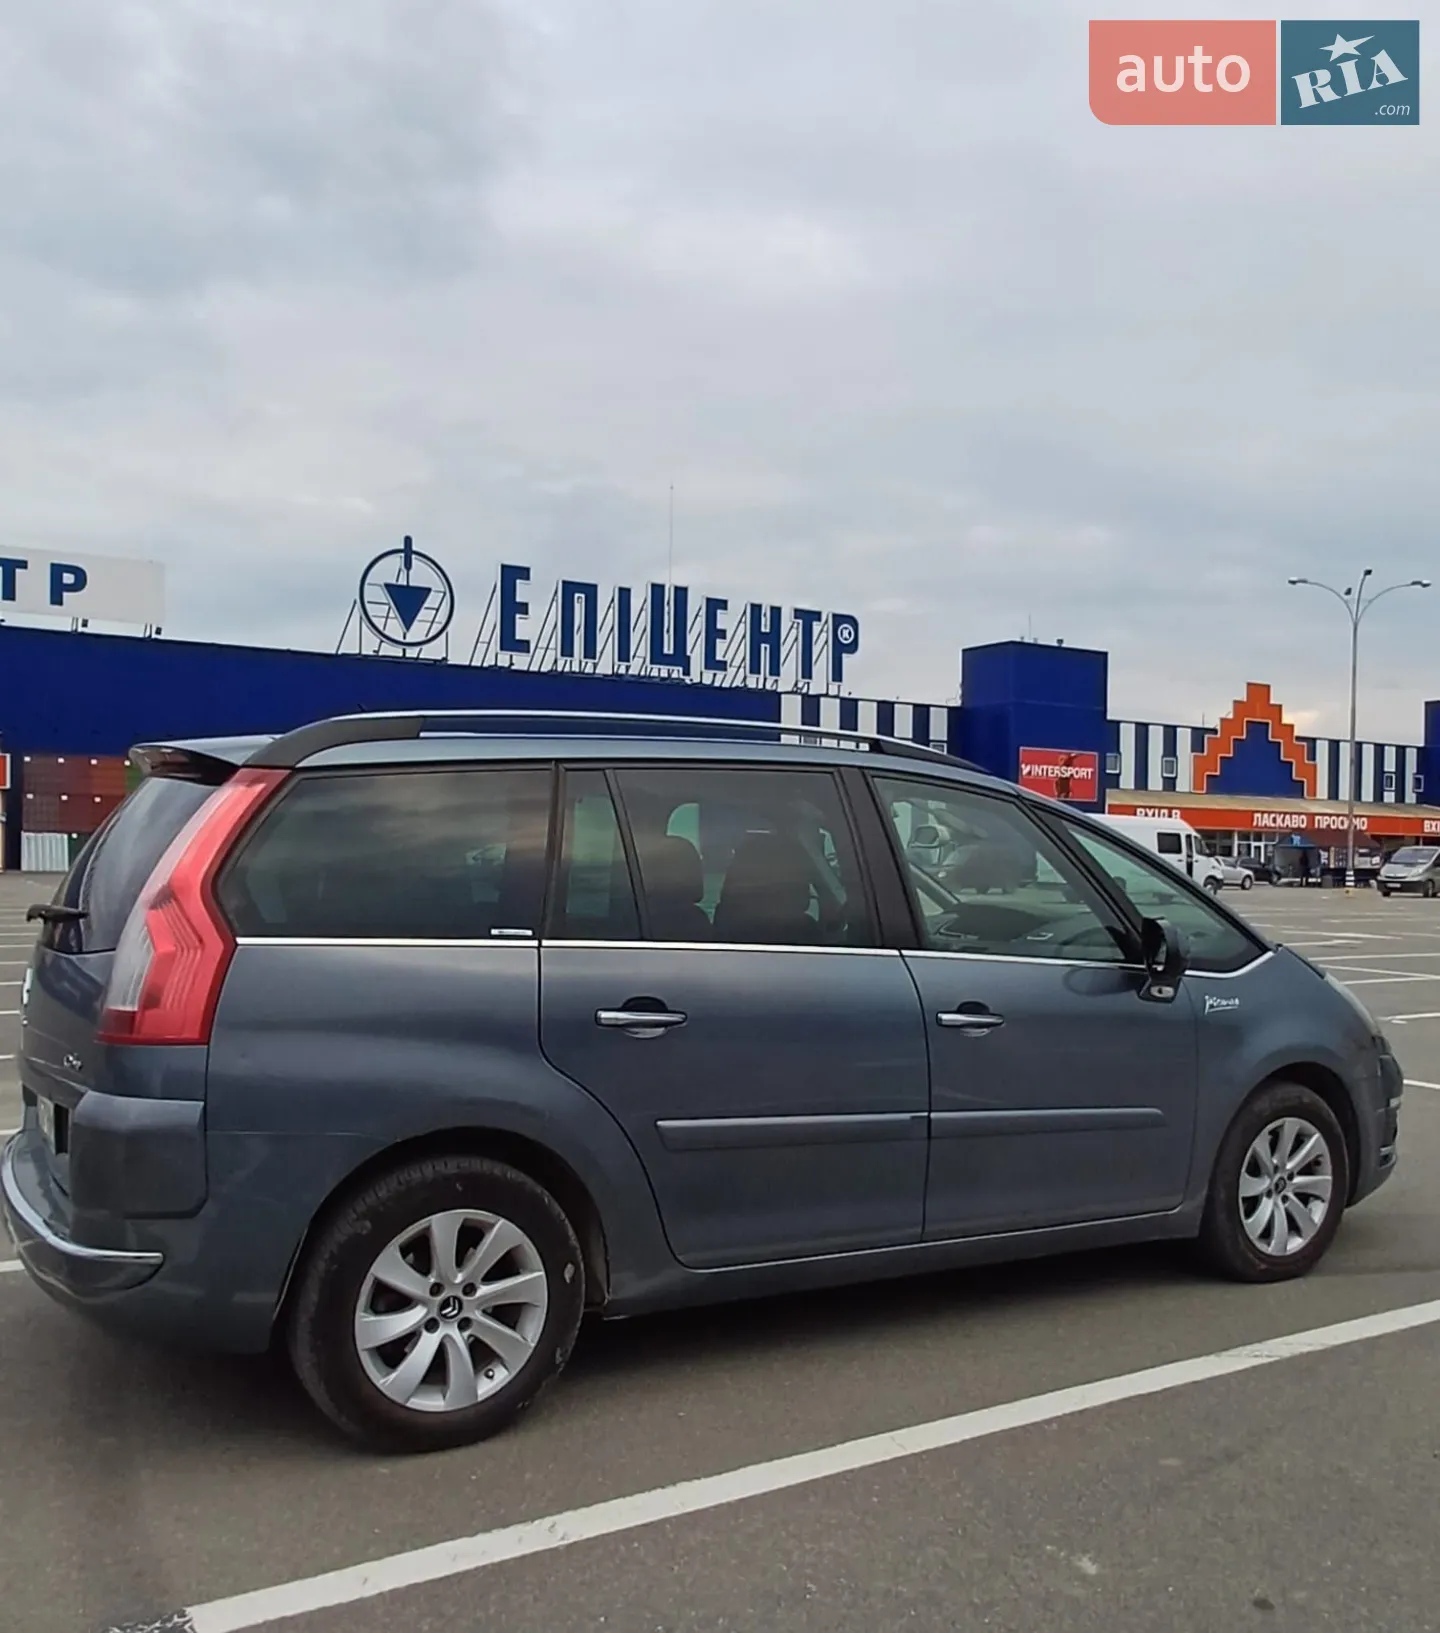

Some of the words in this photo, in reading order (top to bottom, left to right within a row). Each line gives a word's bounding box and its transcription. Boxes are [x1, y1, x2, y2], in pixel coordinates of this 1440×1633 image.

[500, 563, 859, 684] ЕПІЦЕНТР
[1031, 764, 1094, 780] INTERSPORT
[1253, 813, 1307, 828] ЛАСКАВО
